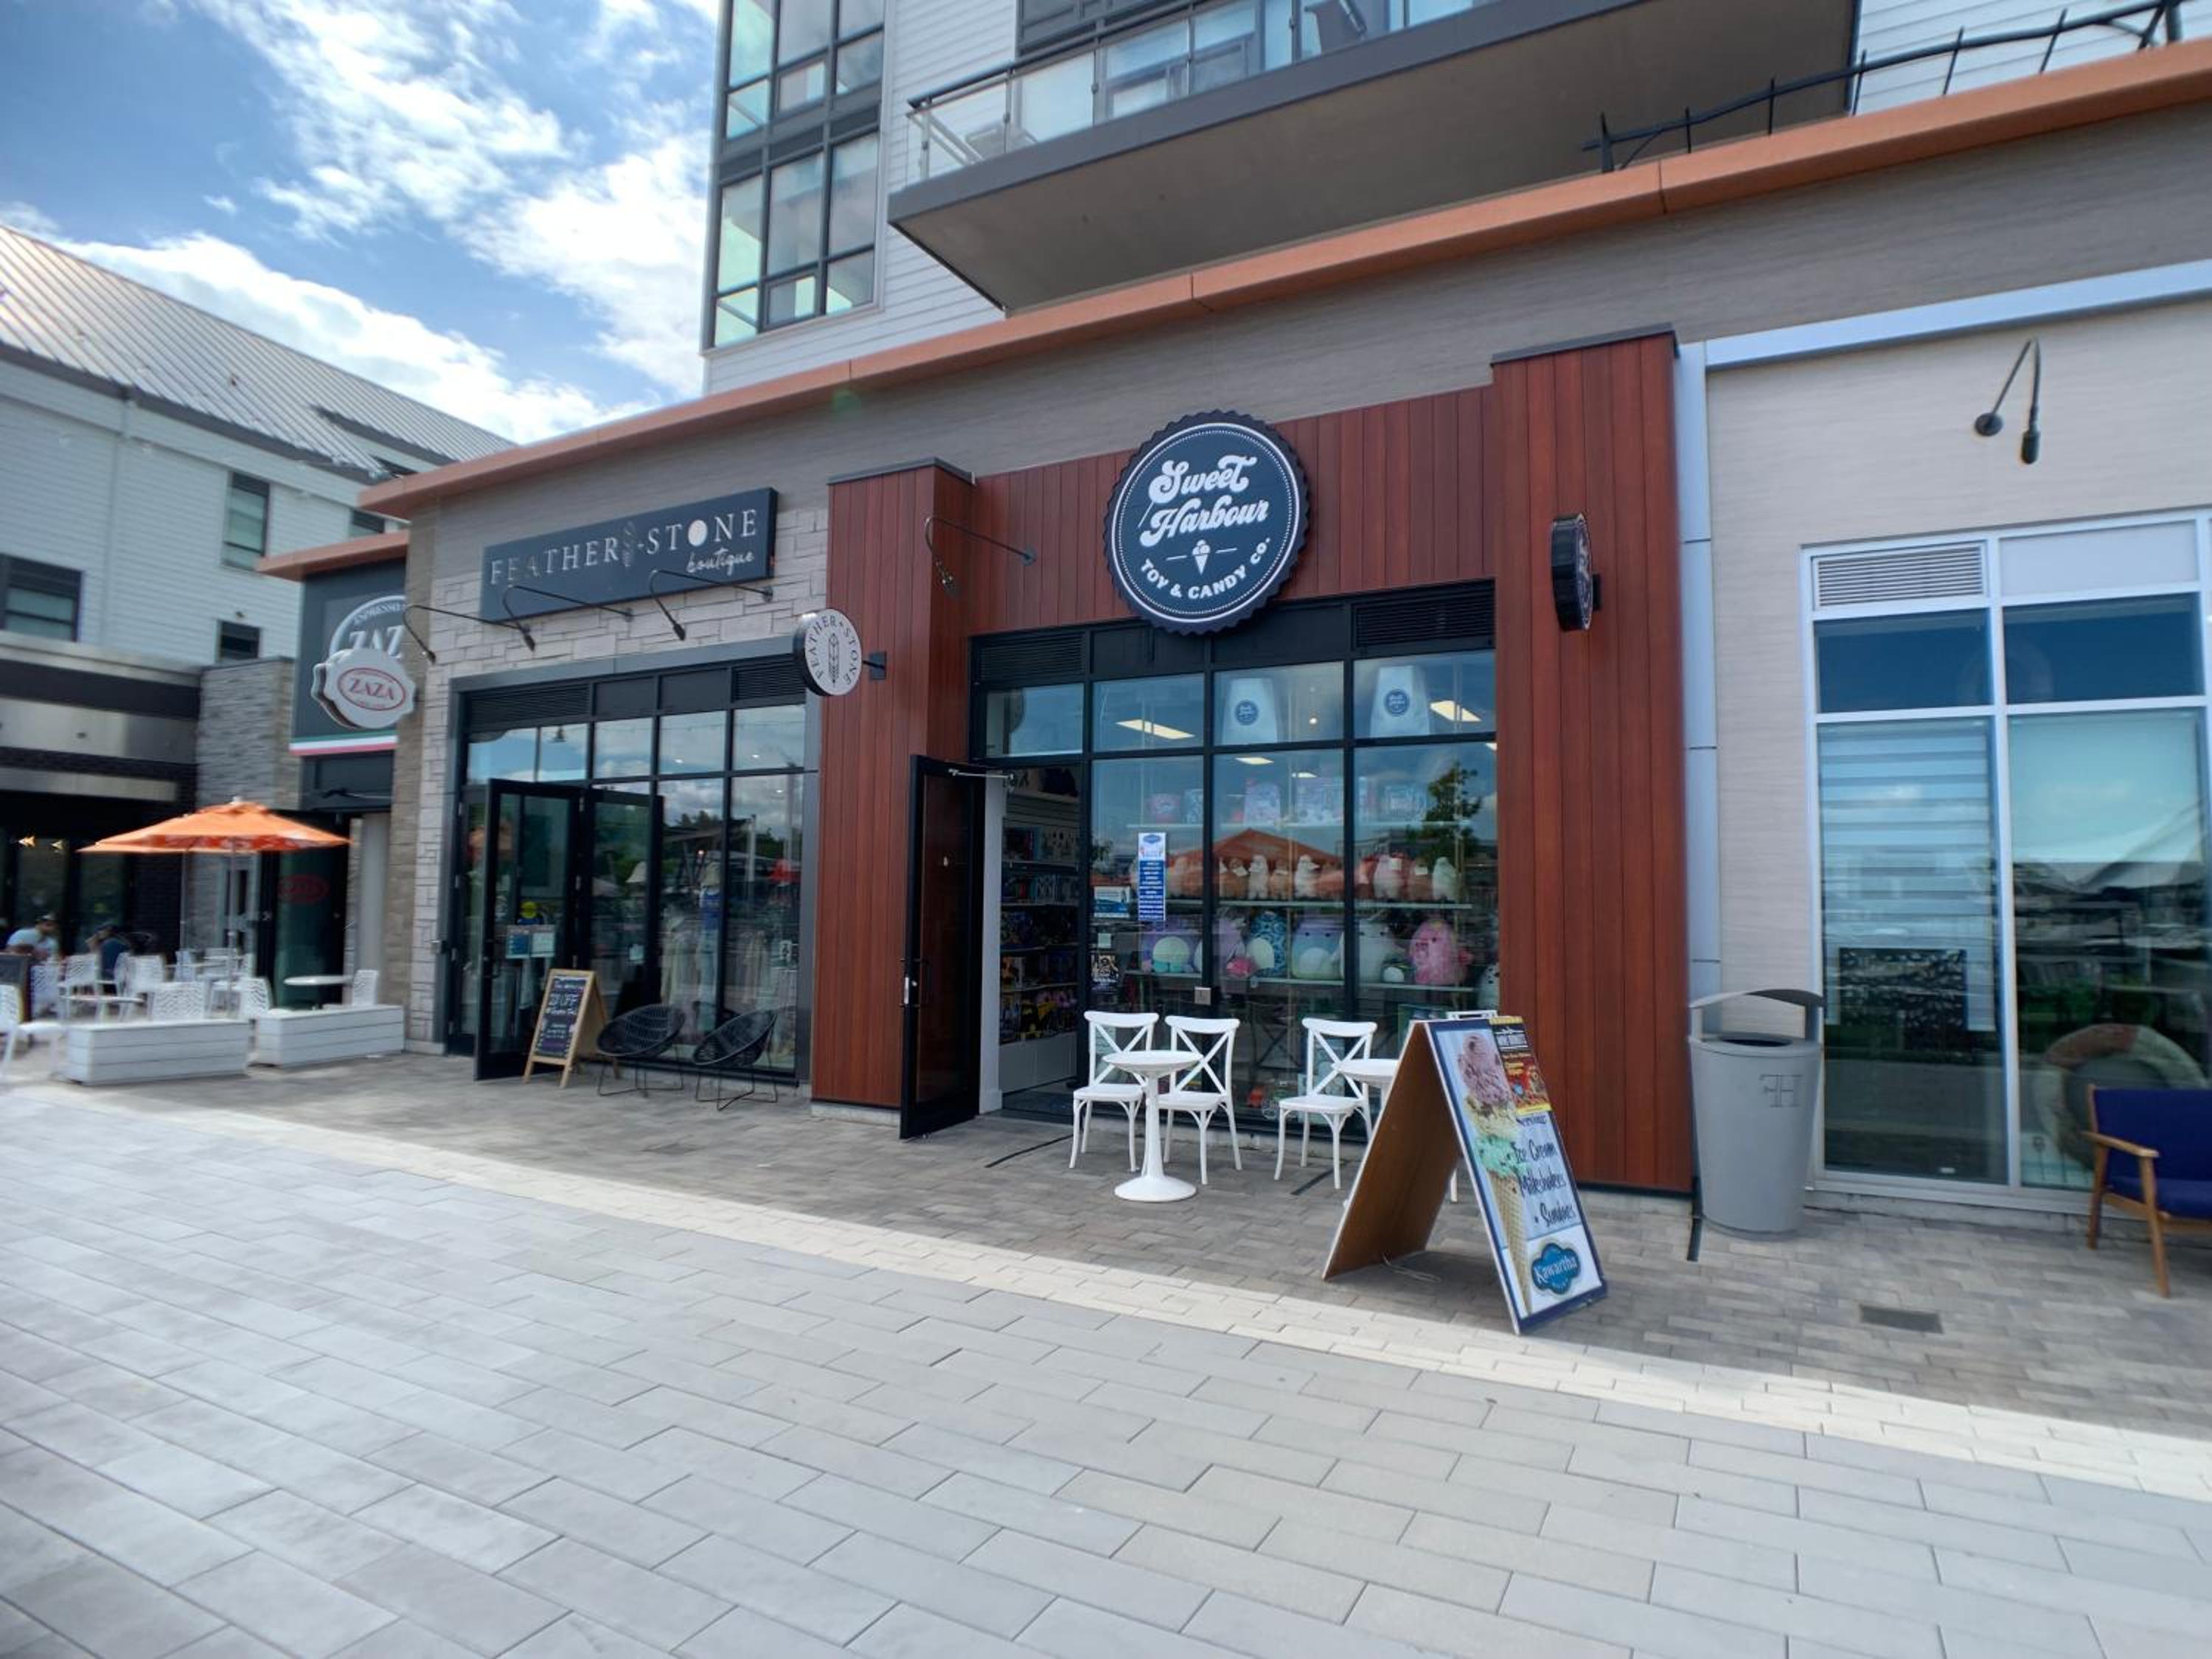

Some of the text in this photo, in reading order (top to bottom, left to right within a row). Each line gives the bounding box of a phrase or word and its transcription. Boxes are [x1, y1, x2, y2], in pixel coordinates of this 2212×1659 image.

[1140, 495, 1269, 547] Harbour
[490, 509, 756, 584] FEATHER STONE
[1141, 558, 1169, 591] TOY
[1169, 583, 1183, 599] &
[1188, 565, 1248, 599] CANDY
[349, 625, 403, 658] ZAZ
[349, 678, 394, 700] ZAZA
